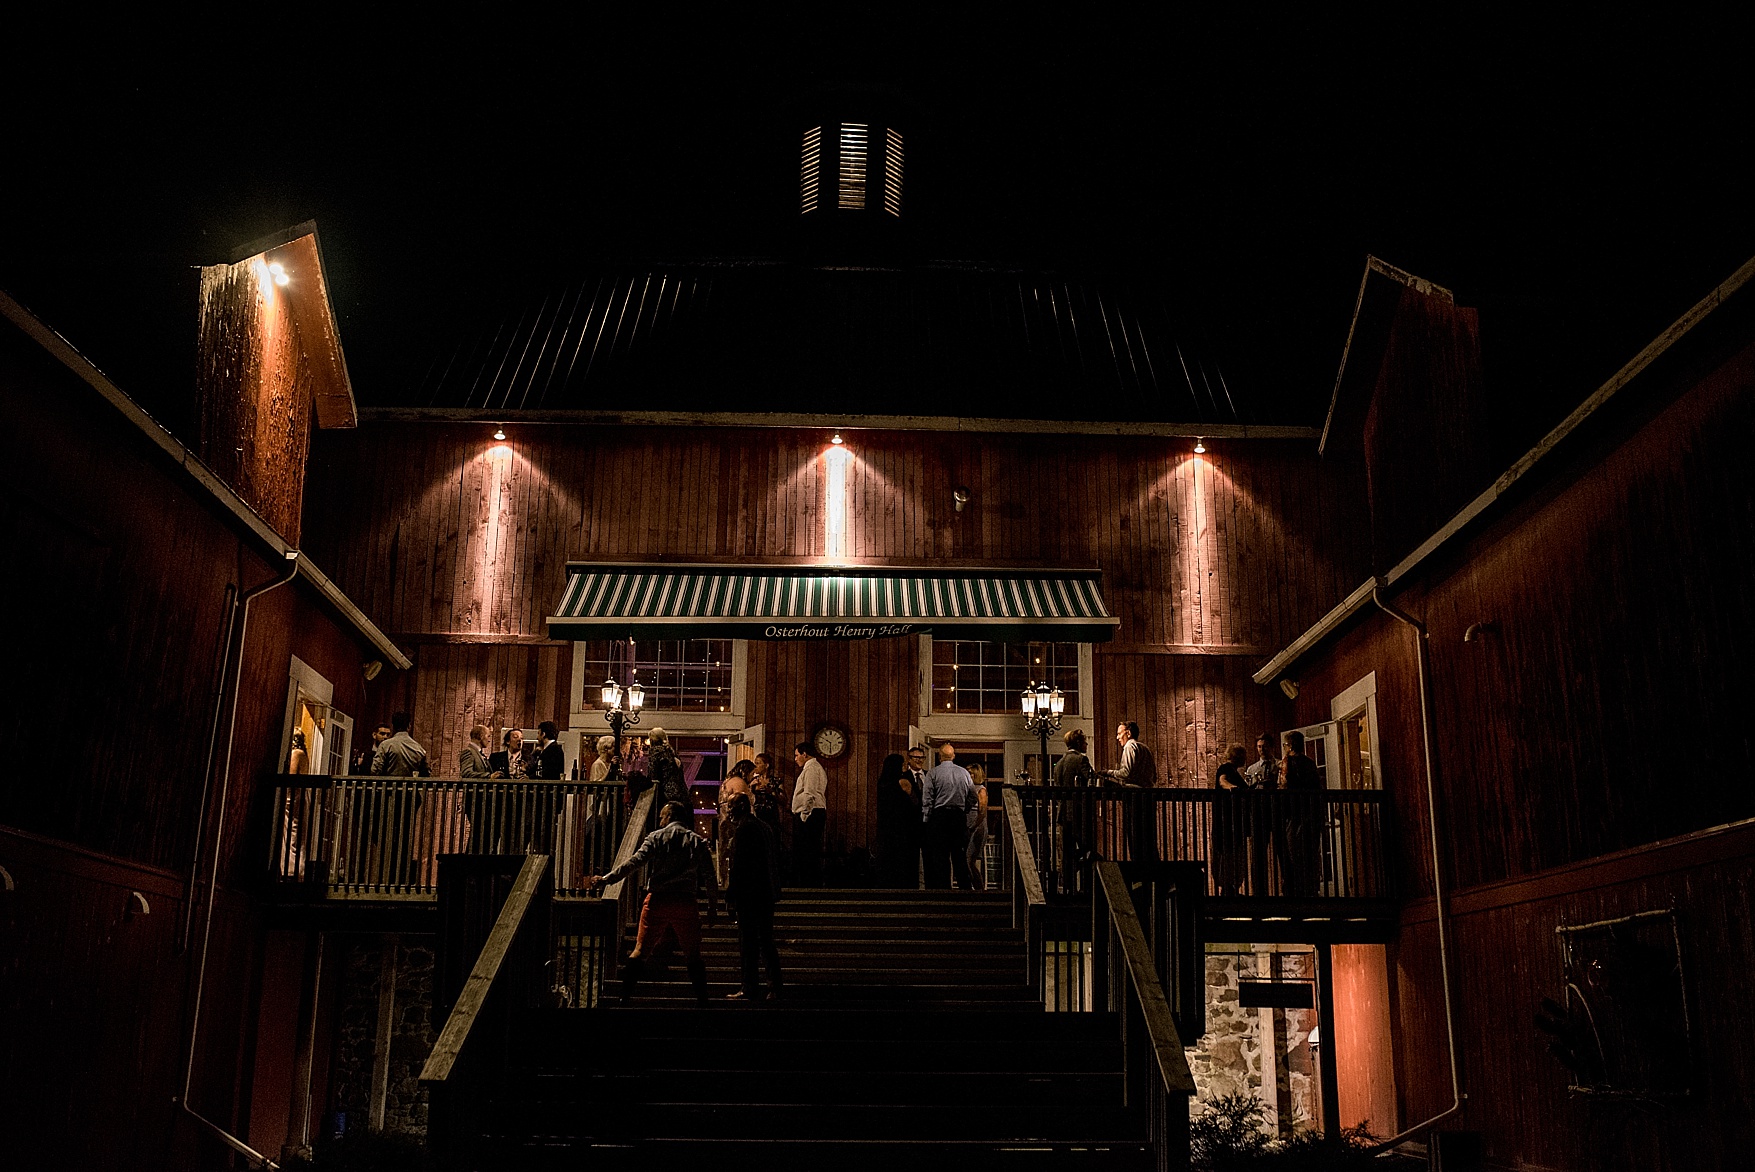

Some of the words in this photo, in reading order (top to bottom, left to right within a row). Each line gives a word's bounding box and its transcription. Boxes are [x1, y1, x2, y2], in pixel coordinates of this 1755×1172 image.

[765, 624, 829, 637] Osterhout
[834, 624, 876, 640] Henry
[879, 624, 912, 635] Hall
